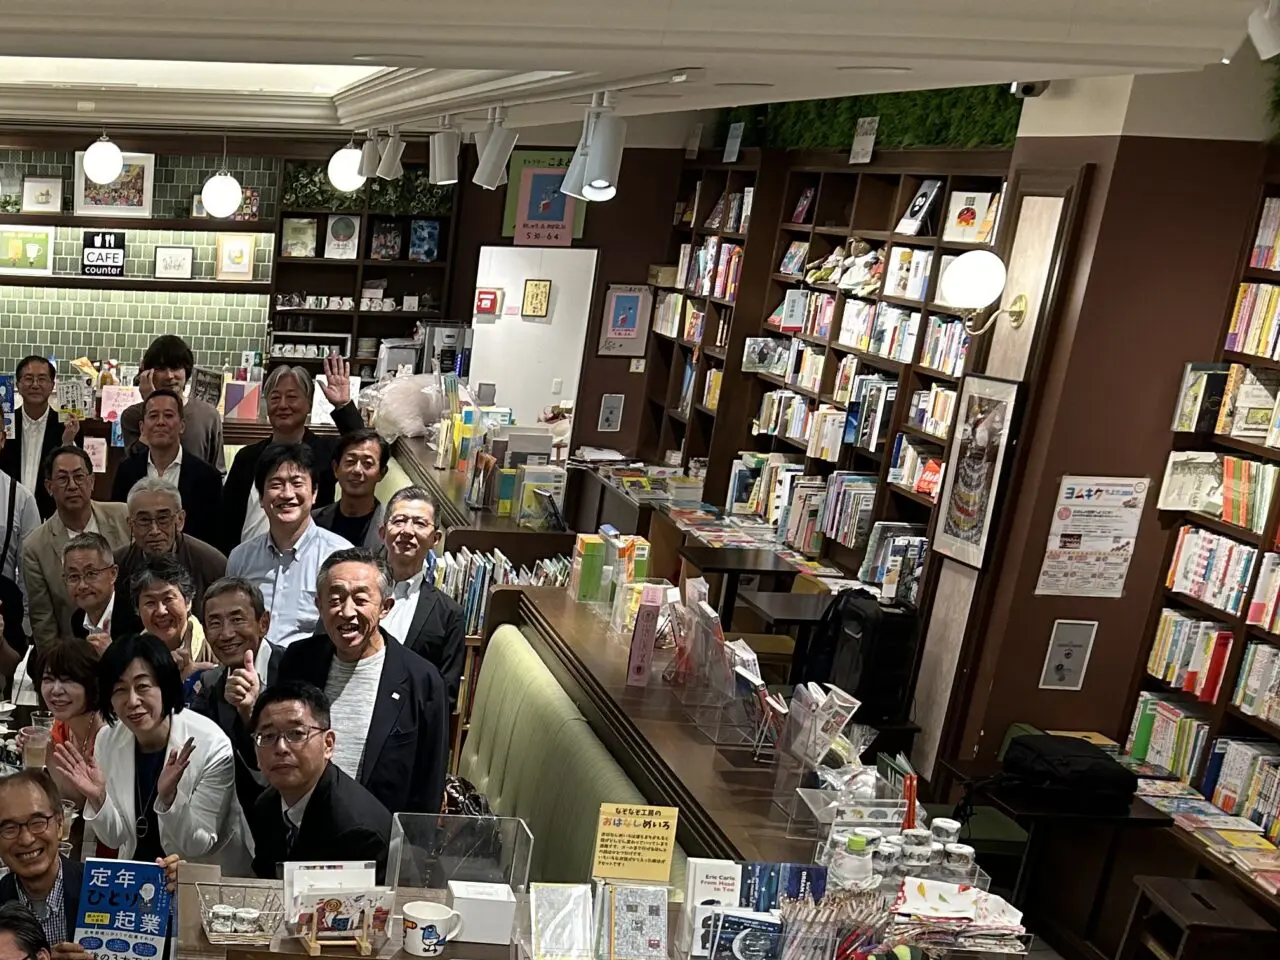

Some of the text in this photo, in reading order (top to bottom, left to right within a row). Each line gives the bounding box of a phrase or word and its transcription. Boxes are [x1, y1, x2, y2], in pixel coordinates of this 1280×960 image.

[86, 251, 120, 264] CAFE
[84, 266, 122, 275] counter
[89, 867, 136, 888] 定年
[87, 888, 138, 907] ひとり
[113, 910, 161, 934] 起業
